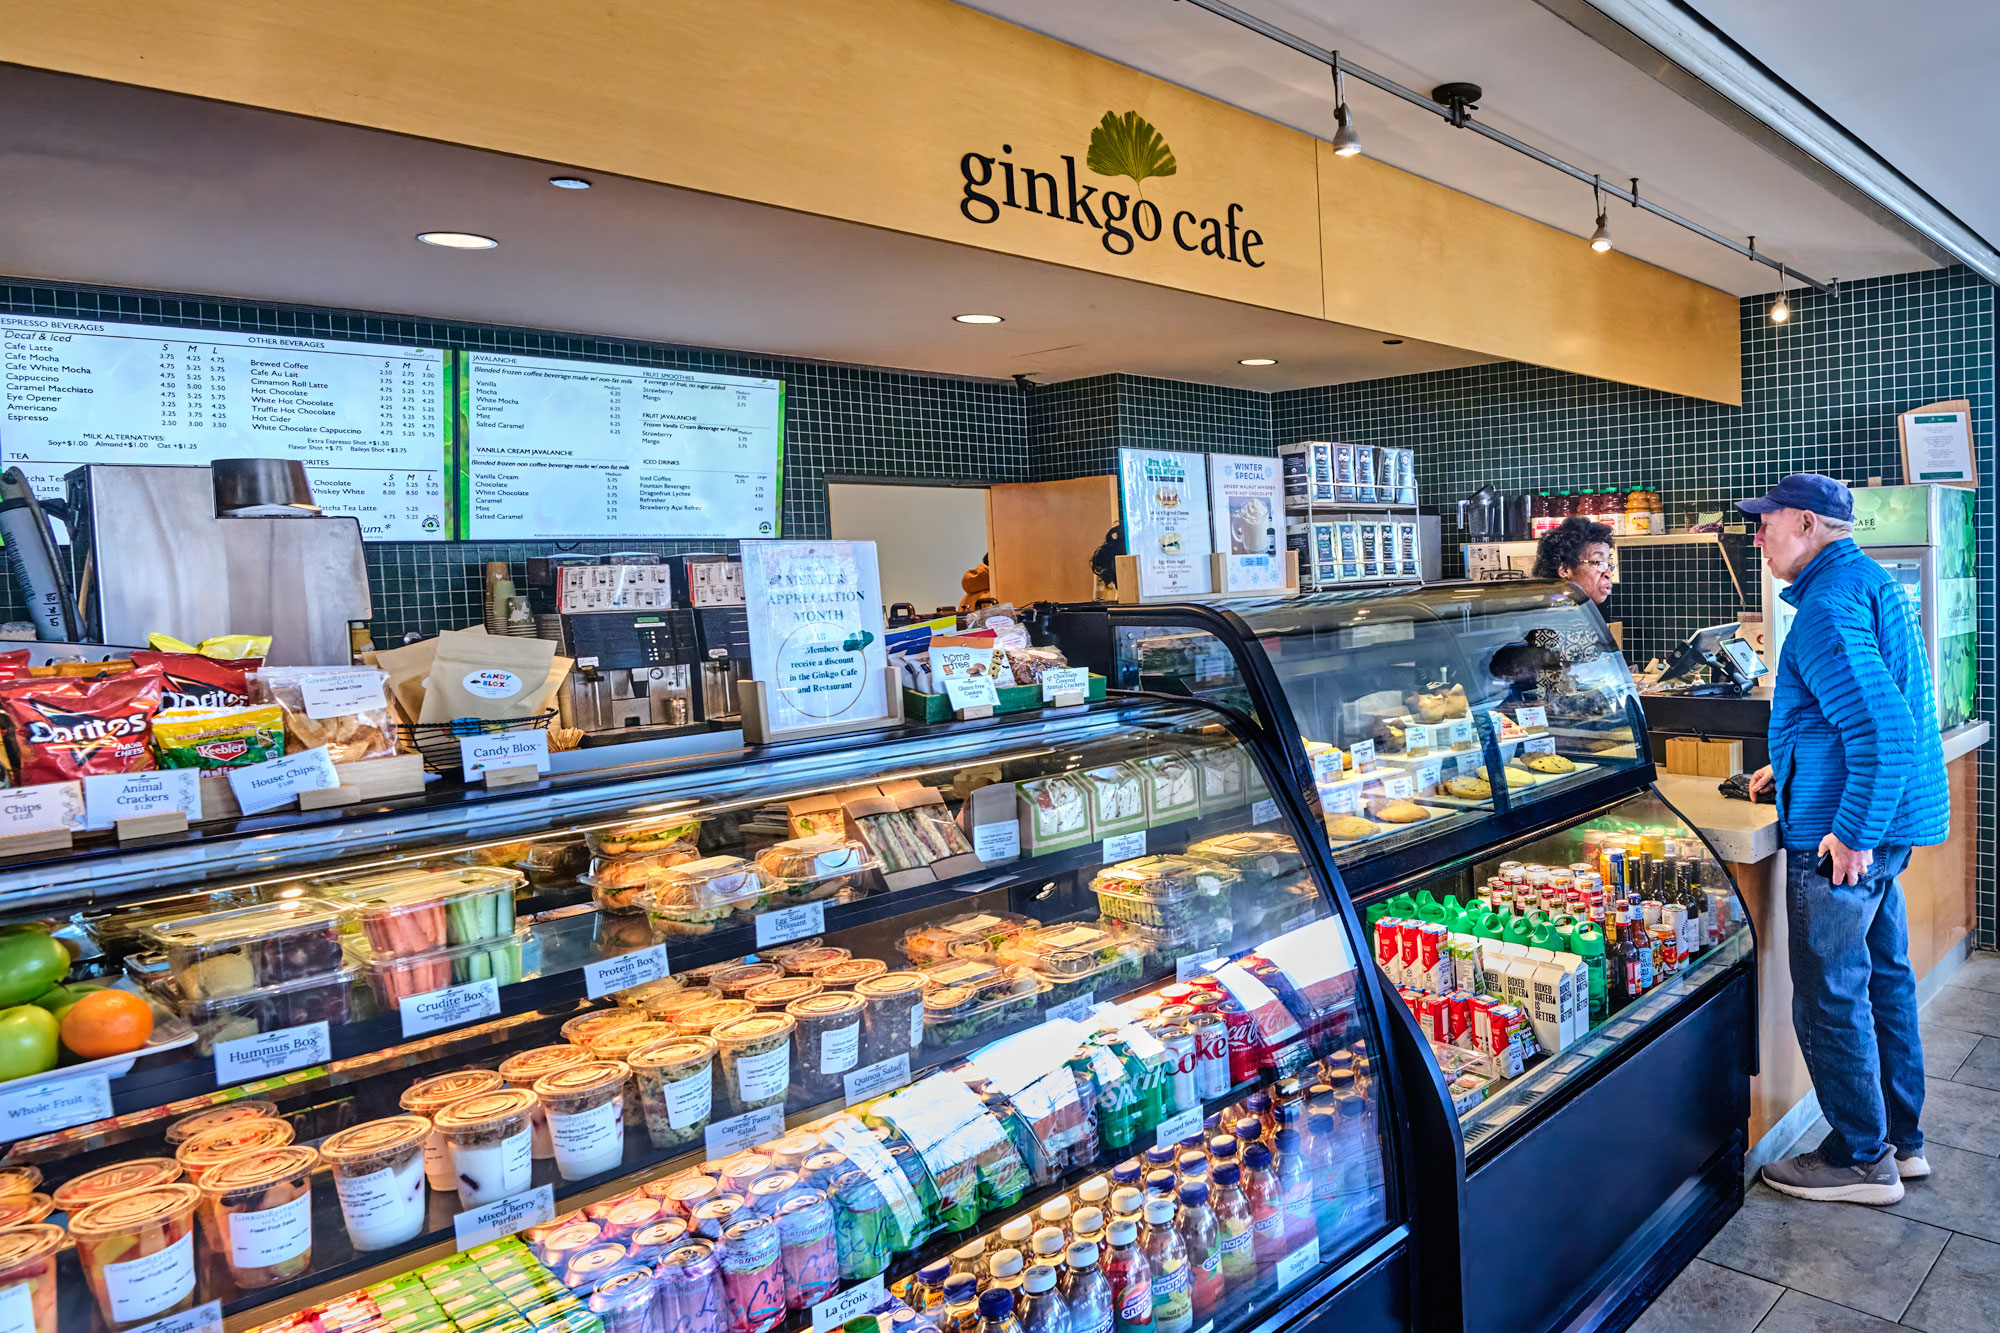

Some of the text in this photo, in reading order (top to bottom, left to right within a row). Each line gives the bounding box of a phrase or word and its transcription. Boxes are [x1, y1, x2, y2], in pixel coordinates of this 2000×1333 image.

[960, 144, 1266, 268] ginkgo cafe
[1, 317, 105, 332] ESPRESSO BEVERAGES
[4, 330, 72, 343] Decaf & Iced
[4, 342, 53, 352] Cafe Latte
[248, 336, 325, 349] OTHER BEVERAGES
[5, 353, 60, 363] Cafe Mocha
[472, 355, 518, 364] JAVALANCHE
[5, 363, 91, 375] Cafe White Mocha
[250, 359, 309, 370] Brewed Coffee
[6, 373, 60, 383] Cappuccino
[251, 369, 269, 377] Cafe
[271, 370, 283, 378] Au
[661, 373, 695, 381] SMOOTHIES
[6, 383, 94, 394] Caramel Macchiato
[251, 378, 329, 389] Cinnamon Roll Latte
[251, 387, 308, 397] Hot Chocolate
[476, 388, 498, 396] Mocha
[643, 387, 673, 395] Strawberry
[6, 393, 62, 403] Eye Opener
[251, 396, 334, 407] White Hot Chocolate
[476, 396, 497, 404] White
[642, 394, 661, 402] Mango
[7, 404, 58, 412] Americano
[252, 405, 278, 414] Truffle
[298, 408, 336, 416] Chocolate
[476, 404, 504, 412] Caramel
[7, 413, 49, 423] Espresso
[252, 414, 292, 423] Hot Cider
[476, 412, 491, 420] Mint
[660, 413, 697, 421] JAVALANCHE
[252, 423, 362, 436] White Chocolate Cappuccino
[476, 420, 525, 430] Salted Caramel
[531, 449, 573, 457] JAVALANCHE
[1234, 463, 1263, 471] WINTER
[1235, 472, 1265, 480] SPECIAL
[793, 609, 844, 623] MONTH
[791, 657, 816, 668] receive
[824, 656, 854, 666] discount
[942, 653, 970, 662] home
[950, 660, 970, 671] free
[480, 672, 512, 680] CANDY
[789, 668, 858, 682] in the Ginkgo Cafe
[797, 682, 853, 694] and Restaurant
[1064, 681, 1085, 689] Crackers
[28, 713, 147, 744] Doritos
[200, 741, 246, 756] Keebler
[473, 743, 537, 758] Candy Blox
[251, 764, 316, 789] House Chips
[121, 782, 163, 794] Animal
[117, 793, 169, 805] Crackers
[4, 803, 42, 815] Chips
[775, 912, 807, 926] Egg Salad
[775, 919, 807, 931] Croissant
[598, 957, 655, 978] Protein Box
[1507, 976, 1525, 989] BOXED
[1507, 986, 1526, 998] WATER
[1534, 982, 1553, 995] BOXED
[416, 991, 485, 1013] Crudite Box
[1508, 995, 1514, 1003] IS
[1534, 991, 1553, 1004] WATER
[1534, 1001, 1540, 1011] IS
[229, 1043, 290, 1063] Hummus
[293, 1036, 318, 1049] Box
[854, 1063, 902, 1086] Quinoa Salad
[8, 1095, 83, 1119] Whole Fruit
[721, 1114, 771, 1134] Caprese Pasta
[1163, 1116, 1198, 1137] Canned Soda
[737, 1125, 757, 1136] Salad
[477, 1199, 536, 1224] Mixed Berry
[492, 1212, 523, 1228] Parfait
[824, 1291, 868, 1319] La Croix
